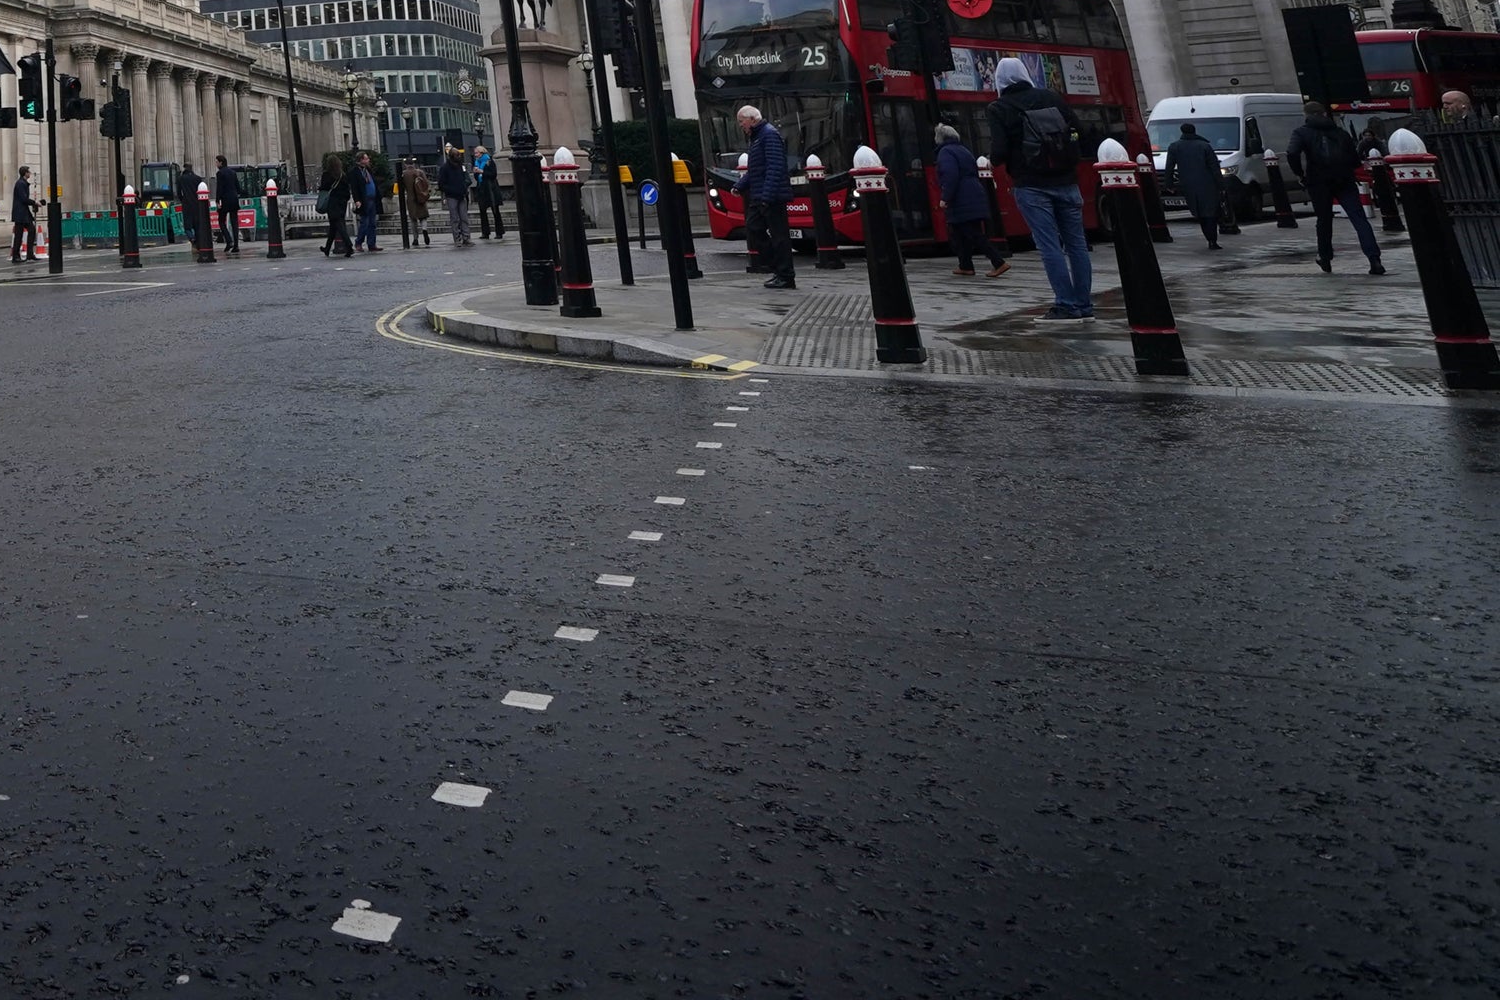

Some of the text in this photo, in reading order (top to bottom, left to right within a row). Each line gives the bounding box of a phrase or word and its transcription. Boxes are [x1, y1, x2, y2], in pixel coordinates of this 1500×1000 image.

[717, 51, 782, 70] City Thameslink
[801, 46, 826, 66] 25
[1391, 81, 1410, 92] 26
